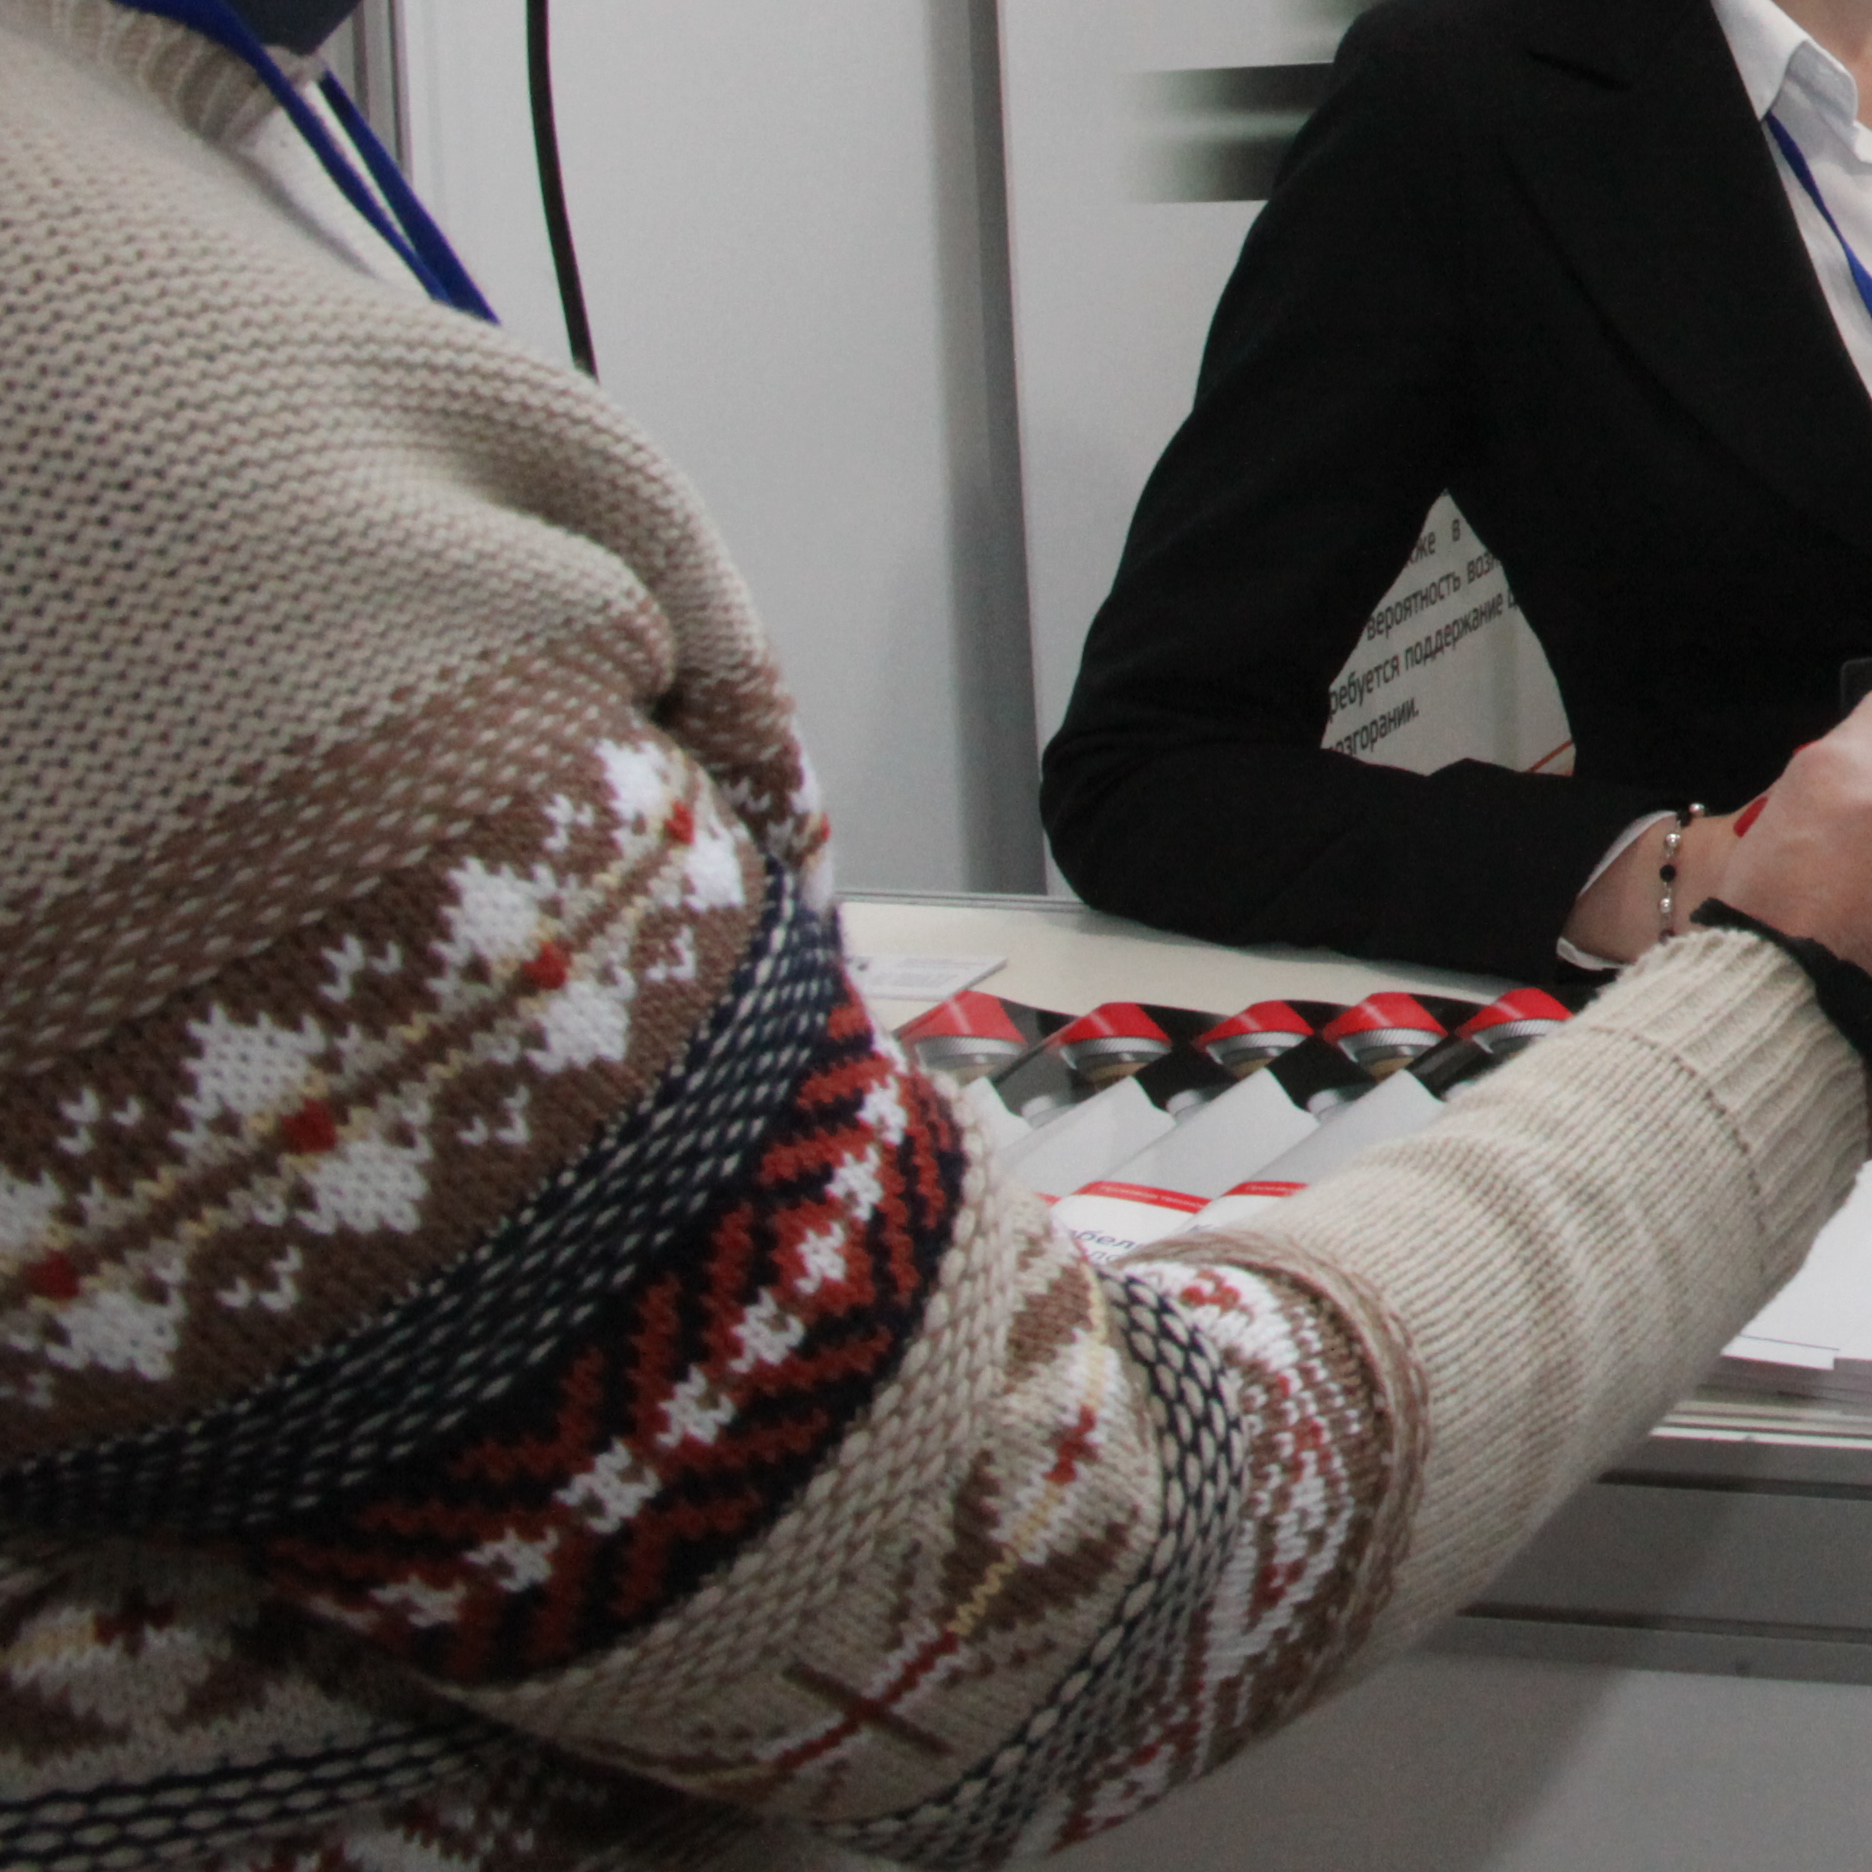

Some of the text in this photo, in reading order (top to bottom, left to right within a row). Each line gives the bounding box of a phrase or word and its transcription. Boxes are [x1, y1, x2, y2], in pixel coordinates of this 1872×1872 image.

[1411, 531, 1436, 564] же
[1466, 551, 1500, 584] воз
[1328, 653, 1400, 722] ребуется
[1332, 696, 1419, 756] озгорании.
